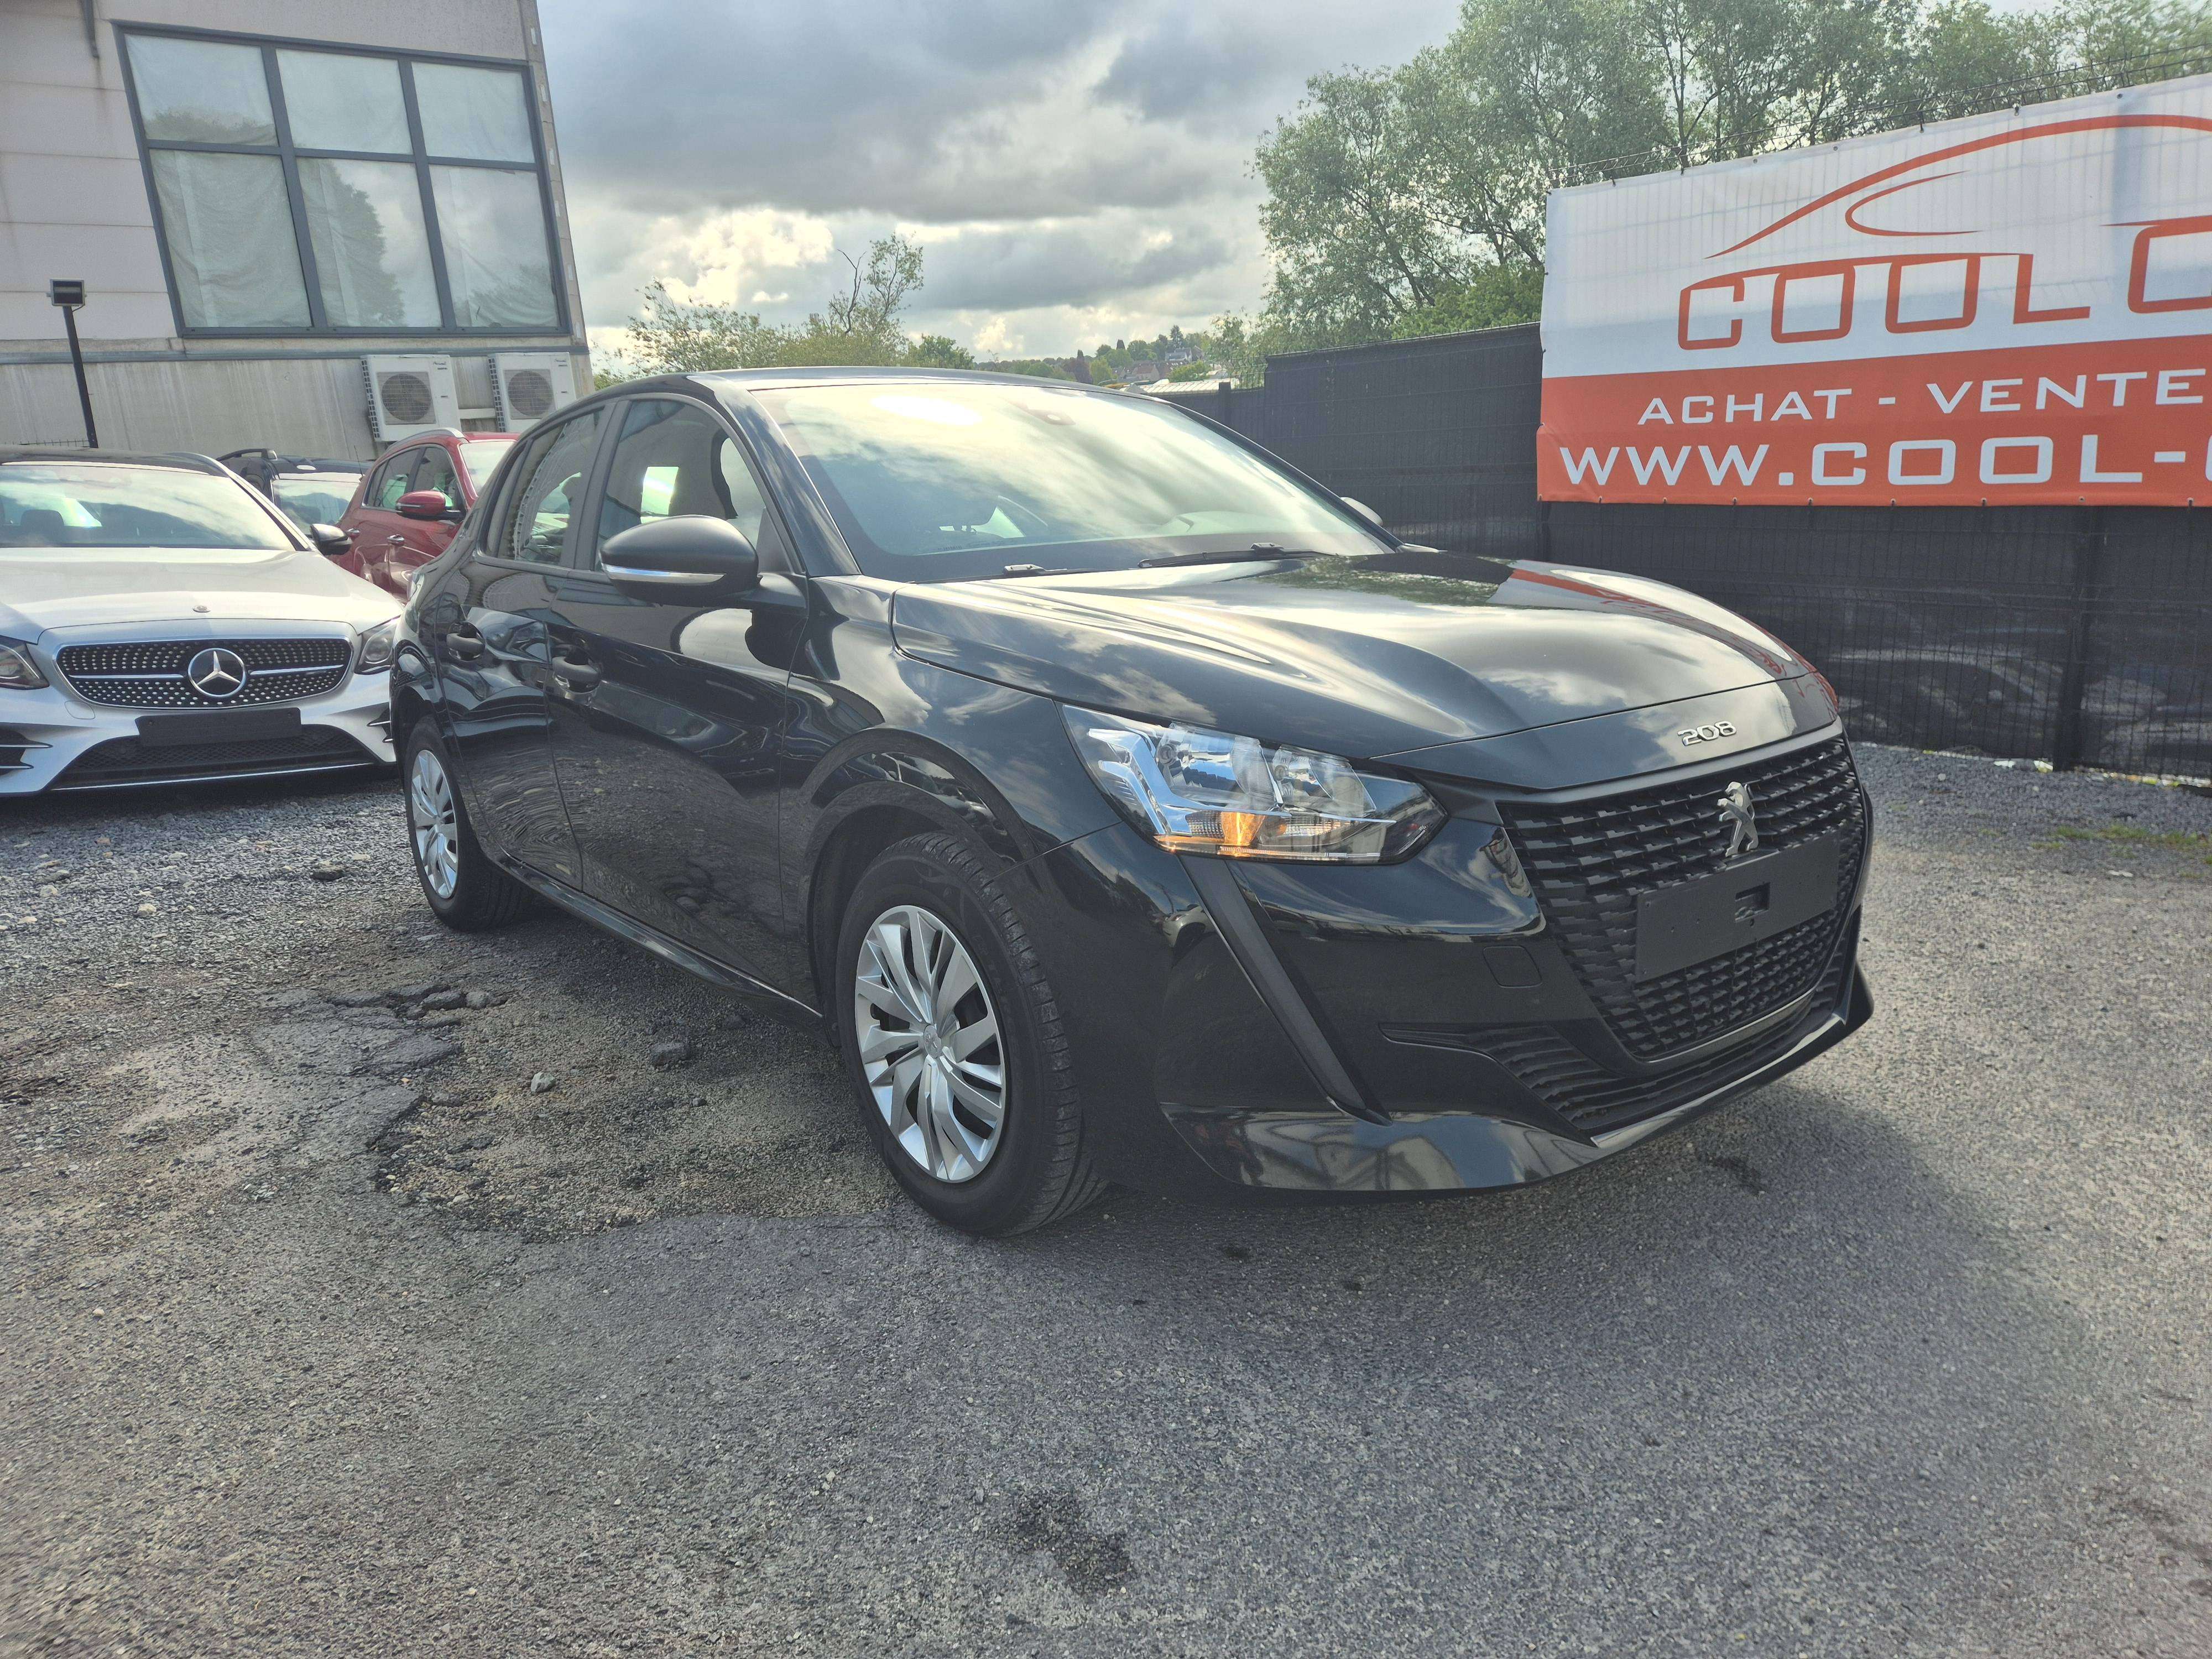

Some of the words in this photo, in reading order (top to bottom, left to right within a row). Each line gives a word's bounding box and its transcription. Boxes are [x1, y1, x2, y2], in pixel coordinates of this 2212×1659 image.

[1678, 253, 2090, 350] COOL
[1638, 389, 1853, 425] ACHAT
[1927, 369, 2206, 414] VENTE
[1559, 435, 2212, 487] WWW.COOL-
[1677, 721, 1736, 746] 208
